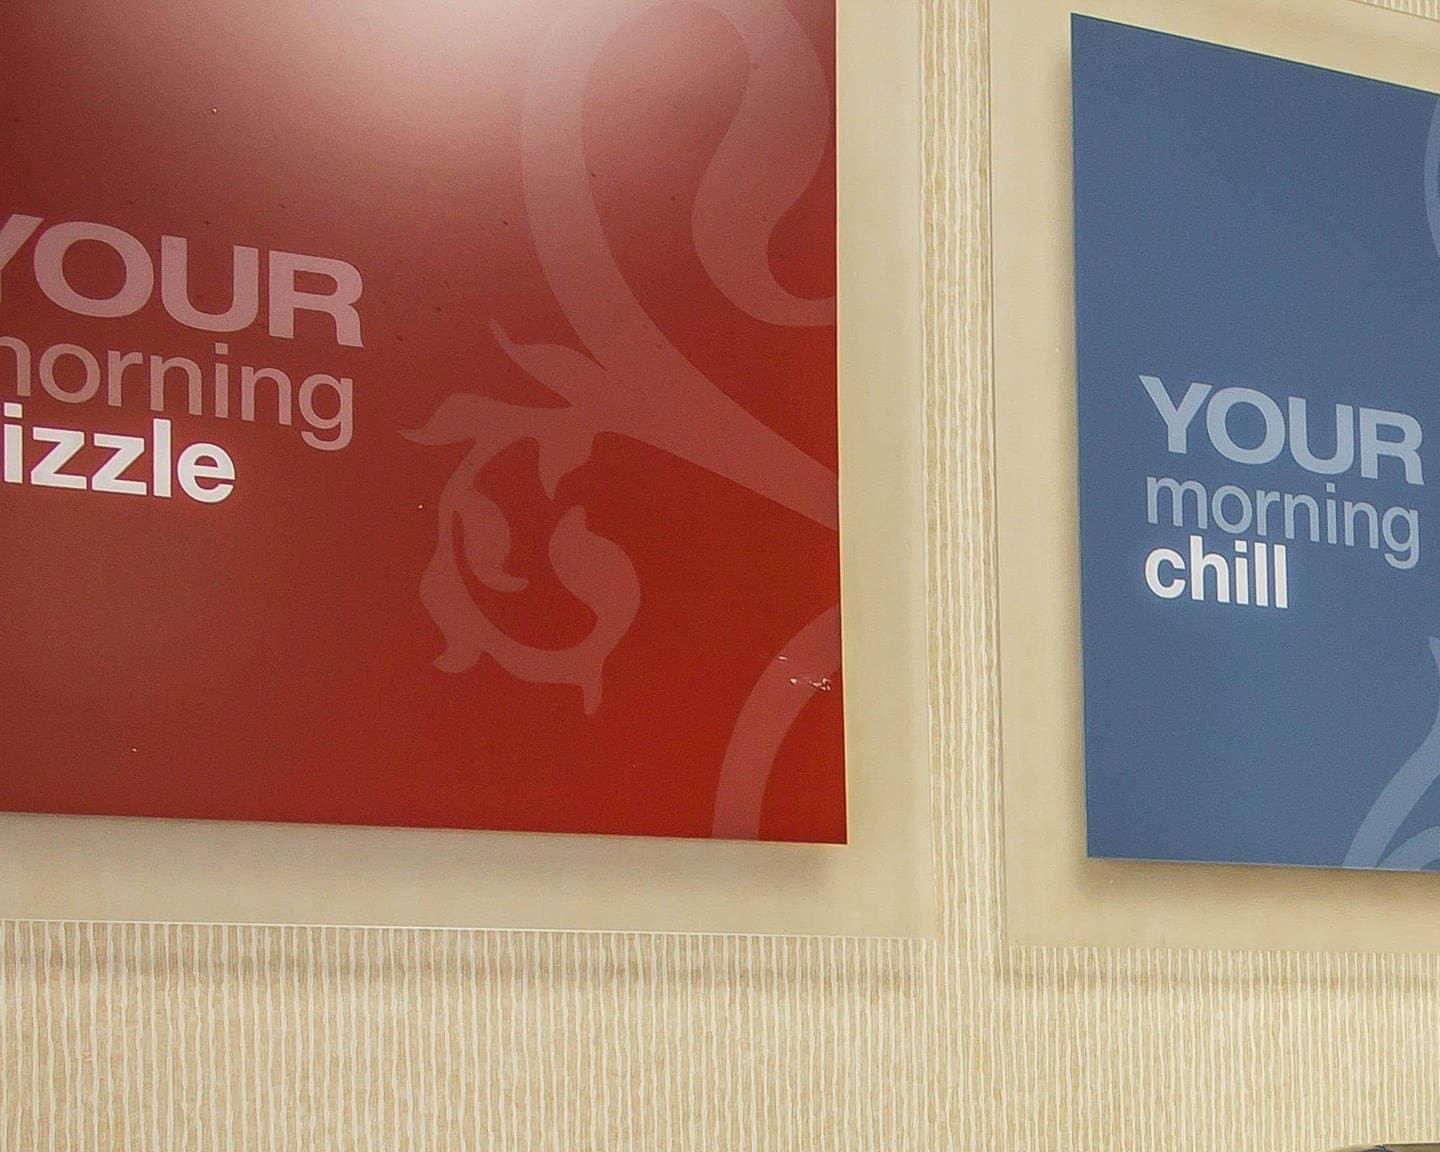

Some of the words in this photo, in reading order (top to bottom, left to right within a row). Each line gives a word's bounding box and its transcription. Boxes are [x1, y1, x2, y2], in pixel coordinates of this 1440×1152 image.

[3, 402, 236, 503] izzle
[1138, 374, 1425, 486] YOUR
[1144, 534, 1288, 609] chill
[1146, 476, 1420, 570] morning
